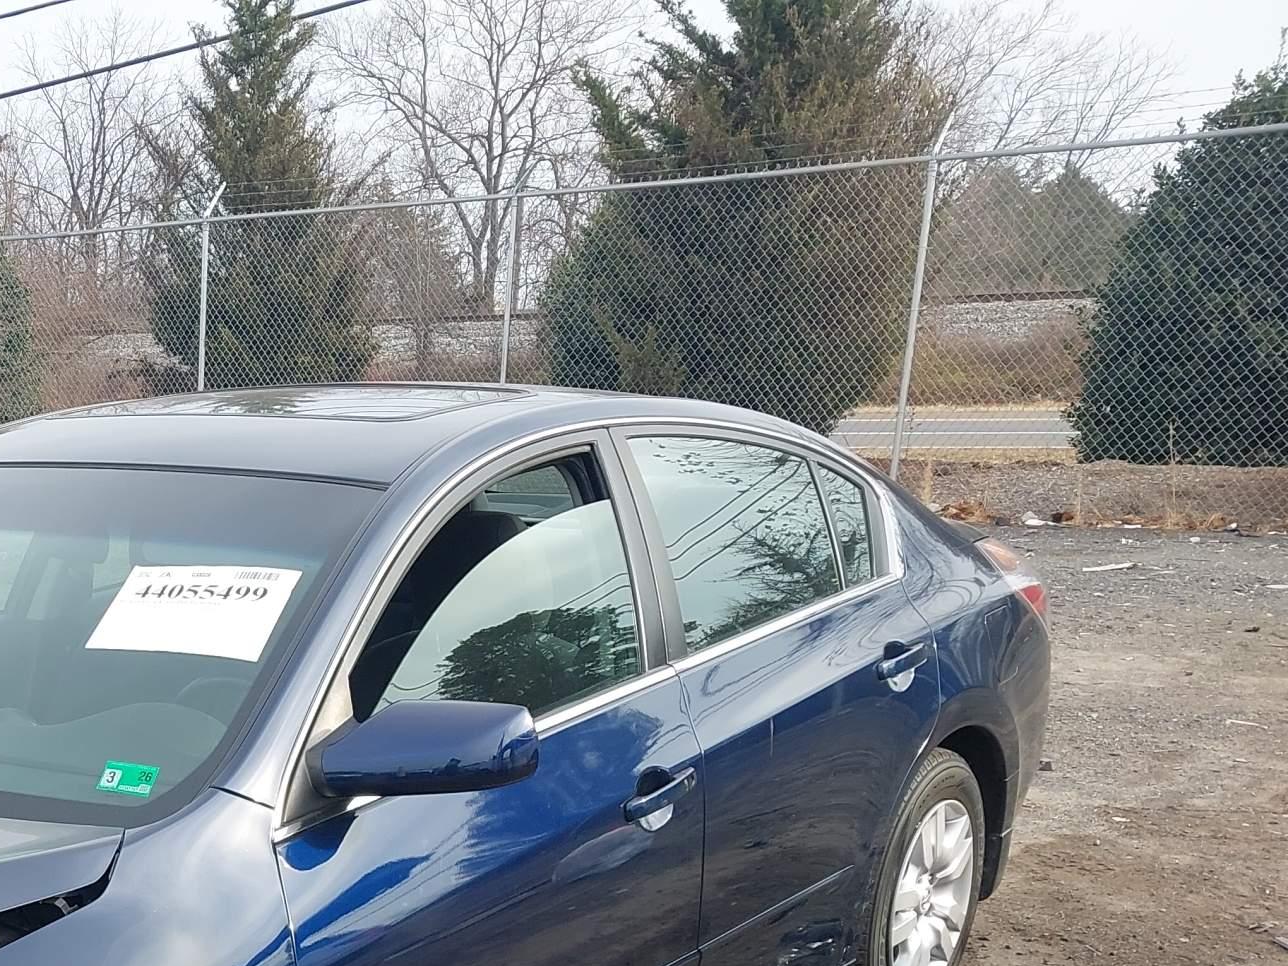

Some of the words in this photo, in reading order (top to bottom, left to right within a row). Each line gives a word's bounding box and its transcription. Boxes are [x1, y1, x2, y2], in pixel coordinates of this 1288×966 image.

[135, 584, 268, 601] 44055499
[106, 771, 116, 783] 3
[138, 771, 153, 782] 26
